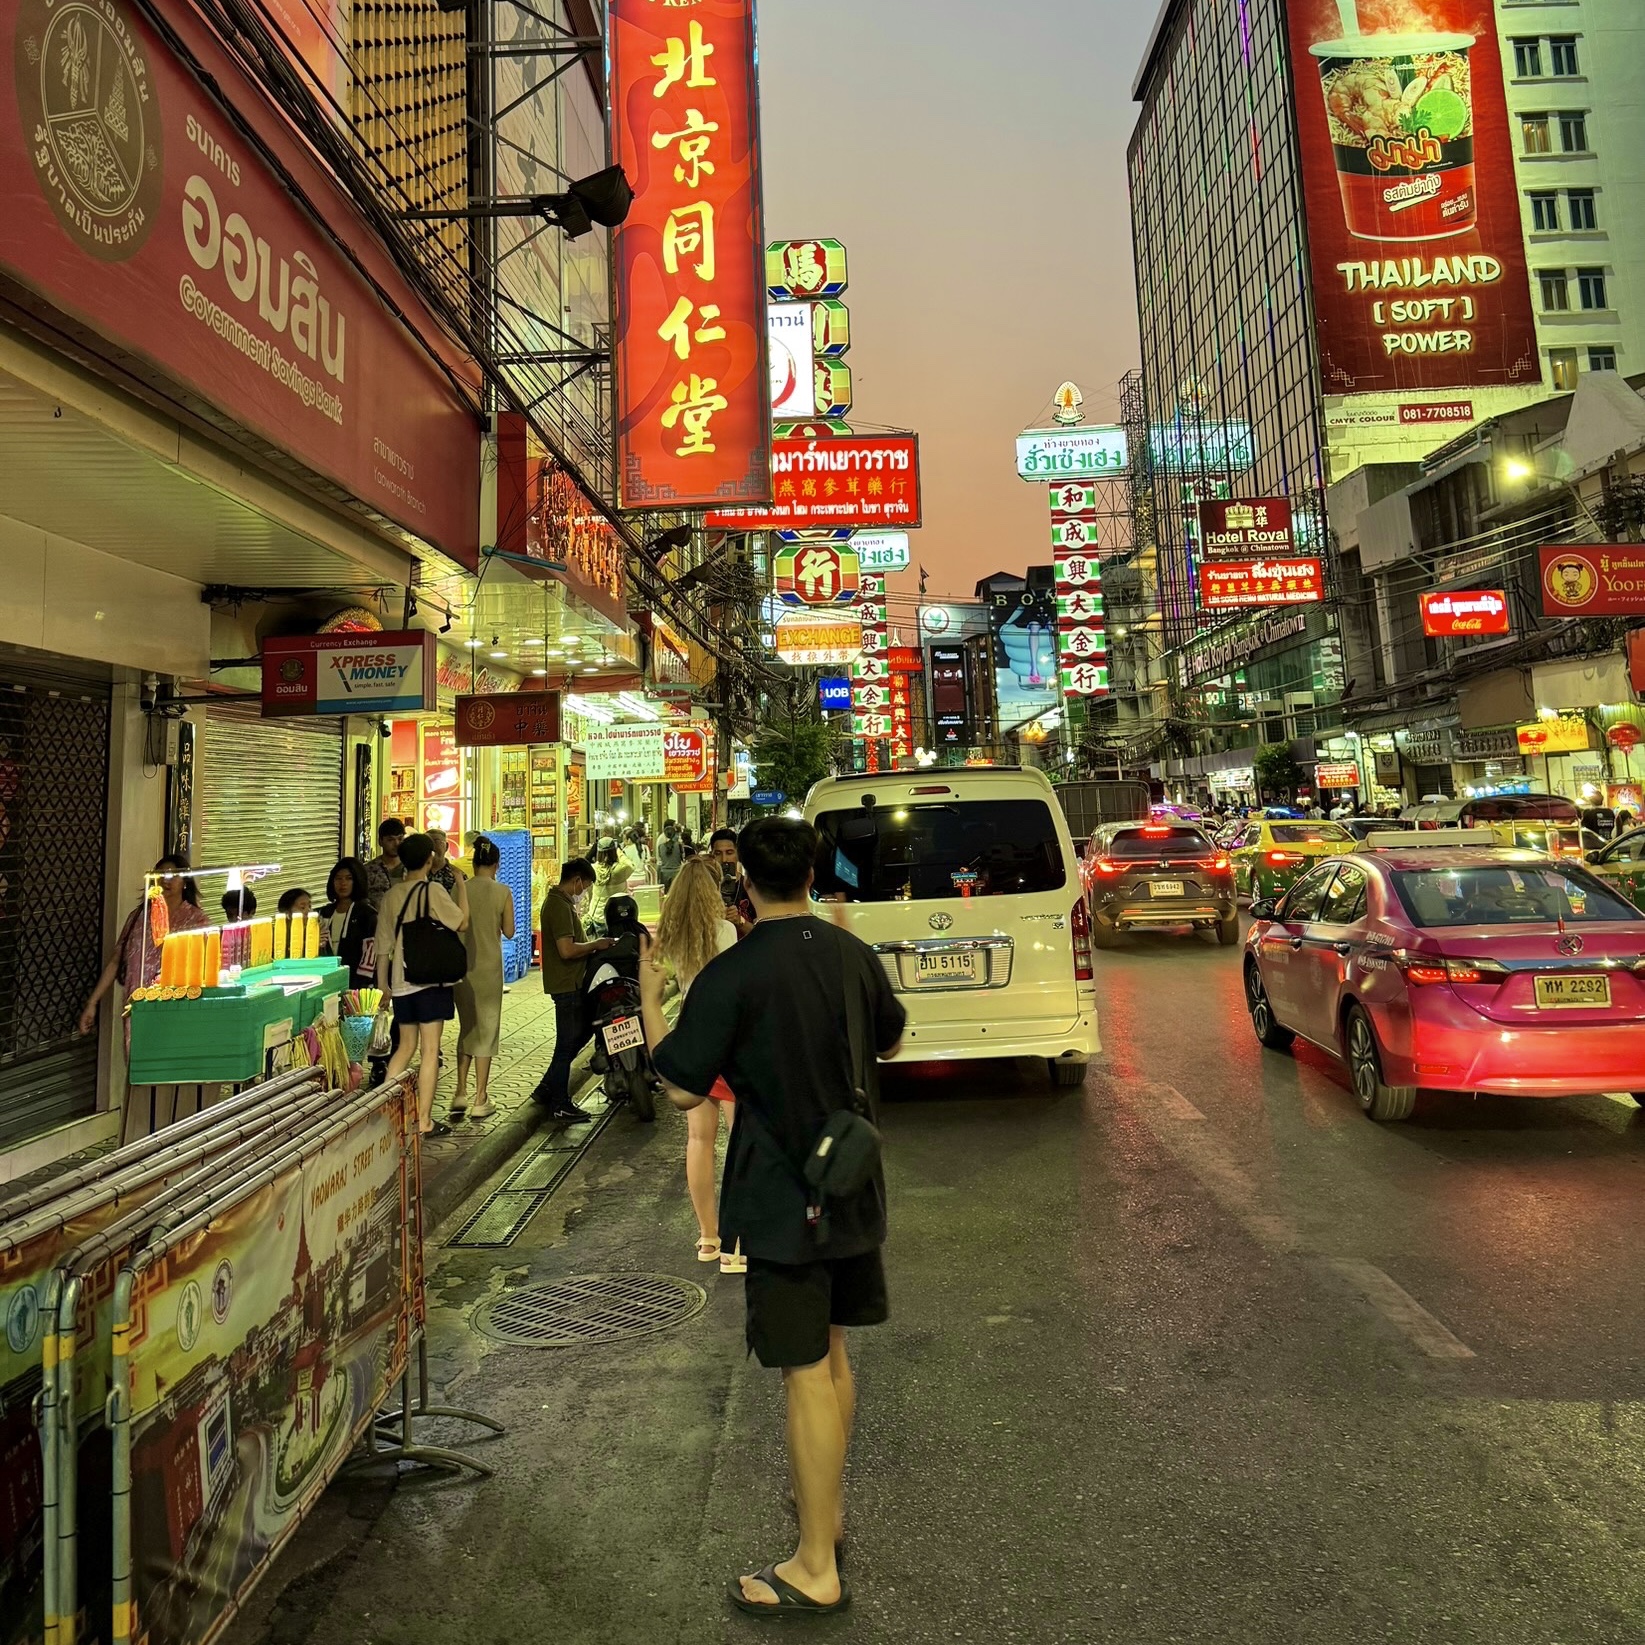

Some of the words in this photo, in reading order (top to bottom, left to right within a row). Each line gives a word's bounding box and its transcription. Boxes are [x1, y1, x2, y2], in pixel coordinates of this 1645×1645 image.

[186, 114, 241, 186] ธนาคาร
[1367, 128, 1442, 171] มาม่า
[650, 19, 728, 458] 北京同仁堂
[182, 174, 346, 383] ออมสิน
[1337, 255, 1501, 290] THAILAND
[180, 274, 271, 372] Government
[271, 347, 316, 406] Savings
[315, 381, 343, 425] Bank
[1383, 330, 1471, 355] POWER
[1330, 416, 1356, 424] CMYK
[1359, 415, 1395, 423] COLOUR
[1403, 406, 1471, 420] 081-7708518
[1206, 530, 1243, 544] Hotel
[1247, 527, 1289, 544] Royal
[1208, 546, 1239, 555] Bangkok
[1250, 544, 1289, 552] Chinatown
[1063, 487, 1096, 690] 和成興大金行
[1257, 592, 1287, 602] NATURAL
[1286, 590, 1318, 601] MEDICINE
[310, 640, 342, 648] Currency
[343, 639, 377, 647] Exchange
[778, 627, 860, 646] EXCHANGE
[1191, 647, 1212, 675] Hotel
[1211, 636, 1232, 668] Royal
[1264, 613, 1306, 644] Chinatown
[330, 653, 396, 669] XPRESS
[350, 665, 409, 680] MONEY
[276, 684, 308, 694] ออมสิน
[825, 687, 849, 698] UOB
[941, 954, 970, 969] 5115
[353, 1142, 375, 1178] STREET
